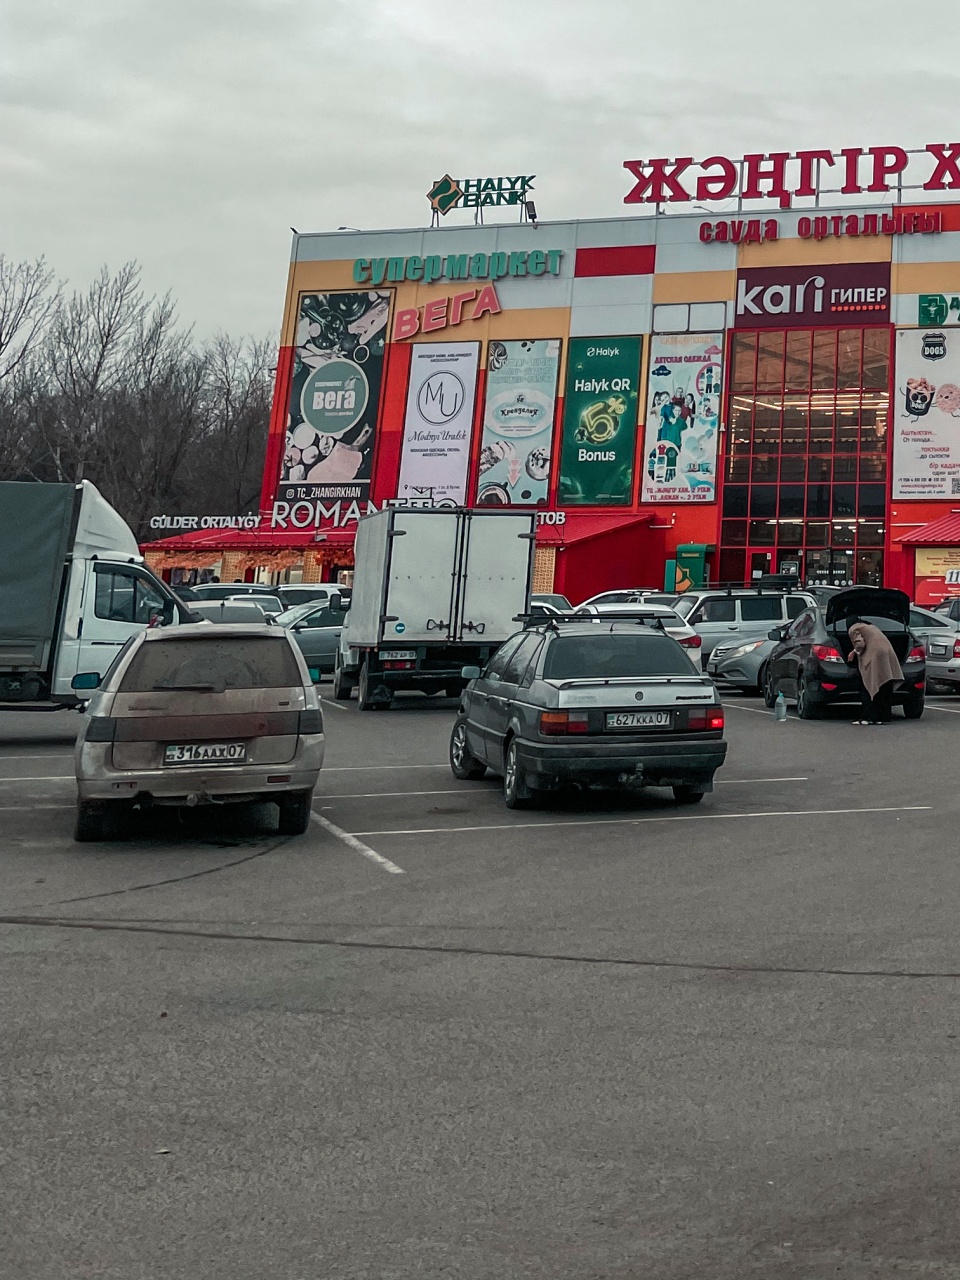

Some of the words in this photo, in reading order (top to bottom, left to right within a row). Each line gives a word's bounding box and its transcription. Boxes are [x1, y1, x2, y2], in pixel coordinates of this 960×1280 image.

[464, 175, 537, 193] HALYK
[623, 145, 909, 208] ЖӘҢГІР
[463, 190, 528, 207] BANK
[699, 218, 778, 244] сауда
[797, 211, 942, 239] орталығы
[352, 248, 564, 286] супермаркет
[737, 275, 826, 316] kari
[830, 286, 887, 304] ГИПЕР
[394, 280, 501, 342] ВЕГА
[596, 346, 620, 357] Halyk
[924, 346, 944, 355] DOGS
[654, 356, 683, 364] ДЕТСКАЯ
[683, 354, 712, 363] ОДЕЖДА
[574, 379, 609, 394] Halyk
[611, 378, 631, 391] QR
[312, 390, 356, 410] вега
[578, 448, 616, 462] Bonus
[296, 486, 361, 500] TC_ZHANGIRKHAN
[537, 511, 566, 525] ТОВ
[656, 712, 669, 723] 07
[228, 744, 244, 758] 07
